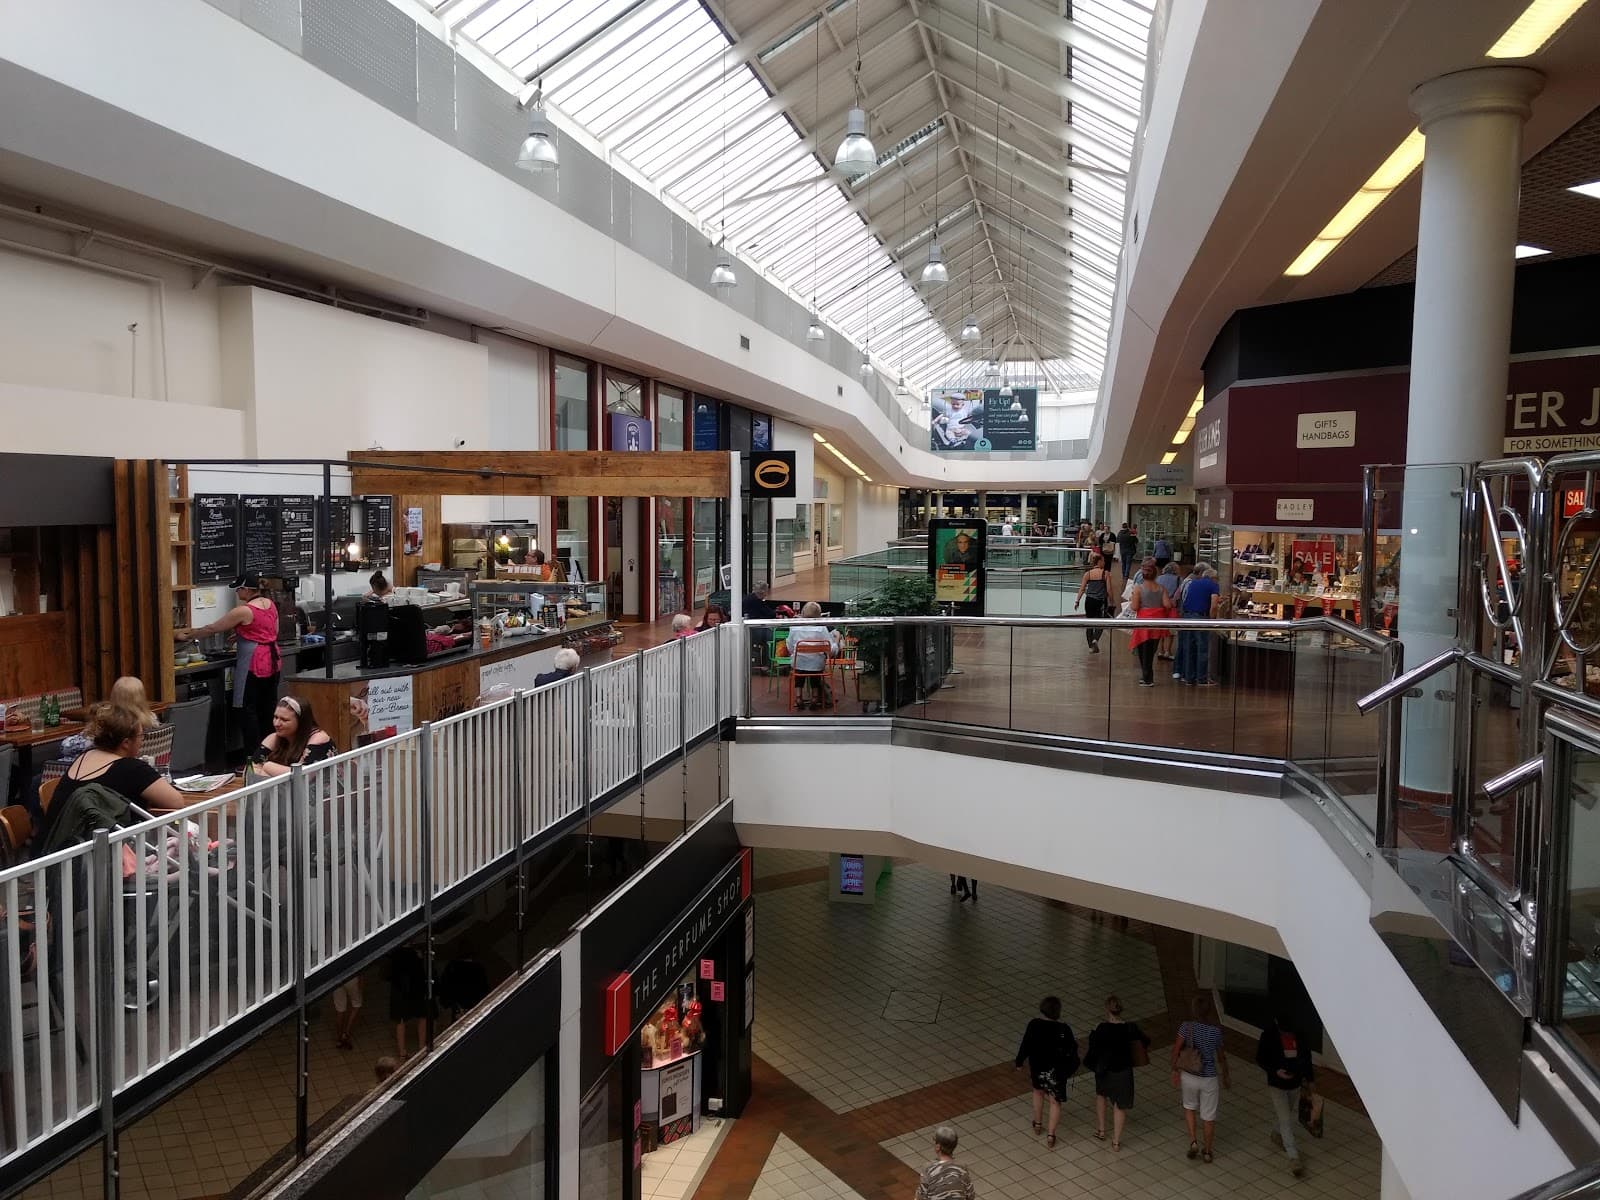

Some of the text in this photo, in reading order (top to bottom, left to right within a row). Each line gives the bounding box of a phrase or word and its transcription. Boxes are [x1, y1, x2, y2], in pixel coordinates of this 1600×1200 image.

[1506, 391, 1567, 429] ER
[1314, 419, 1338, 429] GIFTS
[1302, 430, 1350, 440] HANDBAGS
[1510, 439, 1533, 451] FOR
[1567, 491, 1584, 506] SAL
[1277, 503, 1313, 511] RADLEY
[1295, 551, 1332, 565] SALE
[634, 967, 658, 1009] THE
[665, 906, 713, 975] PERFUME
[717, 876, 742, 915] SHOP
